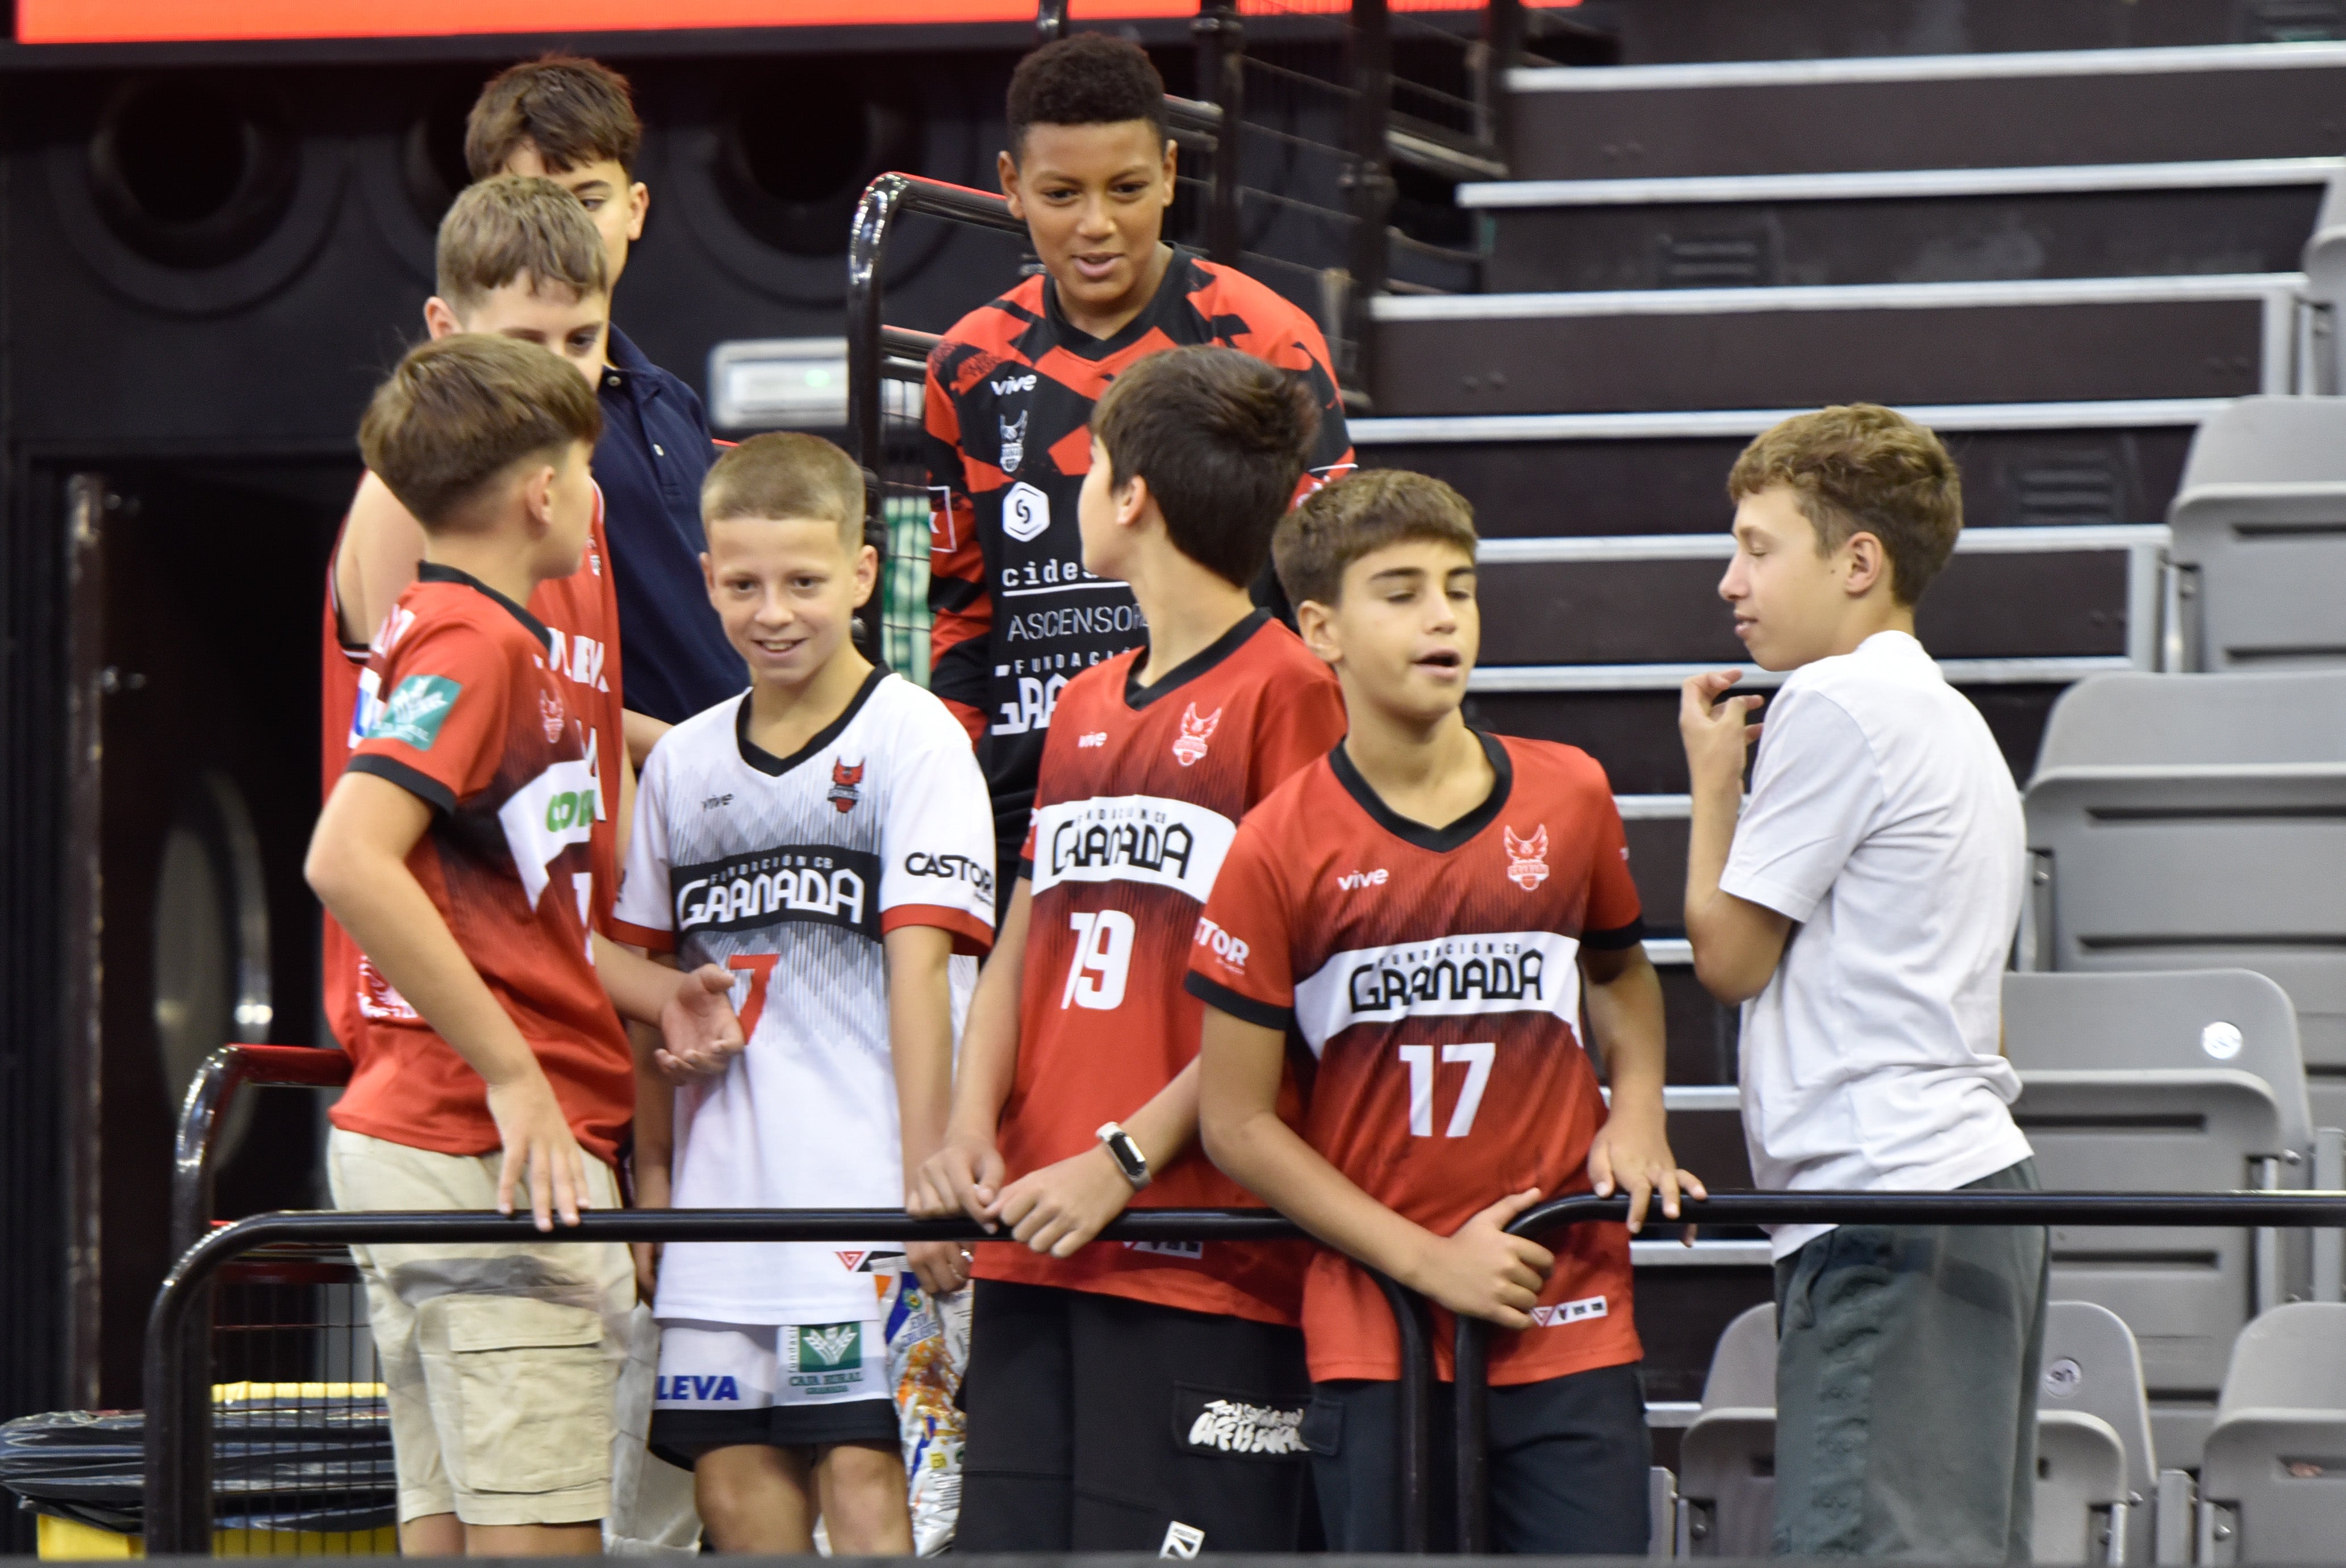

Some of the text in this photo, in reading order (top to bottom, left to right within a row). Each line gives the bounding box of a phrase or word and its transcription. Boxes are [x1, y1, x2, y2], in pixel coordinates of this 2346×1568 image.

[991, 374, 1037, 396] vive
[677, 868, 865, 931] GRANADA
[1337, 868, 1389, 891] vive
[1061, 909, 1135, 1010] 19
[1349, 948, 1544, 1013] GRANADA
[1400, 1042, 1496, 1138] 17
